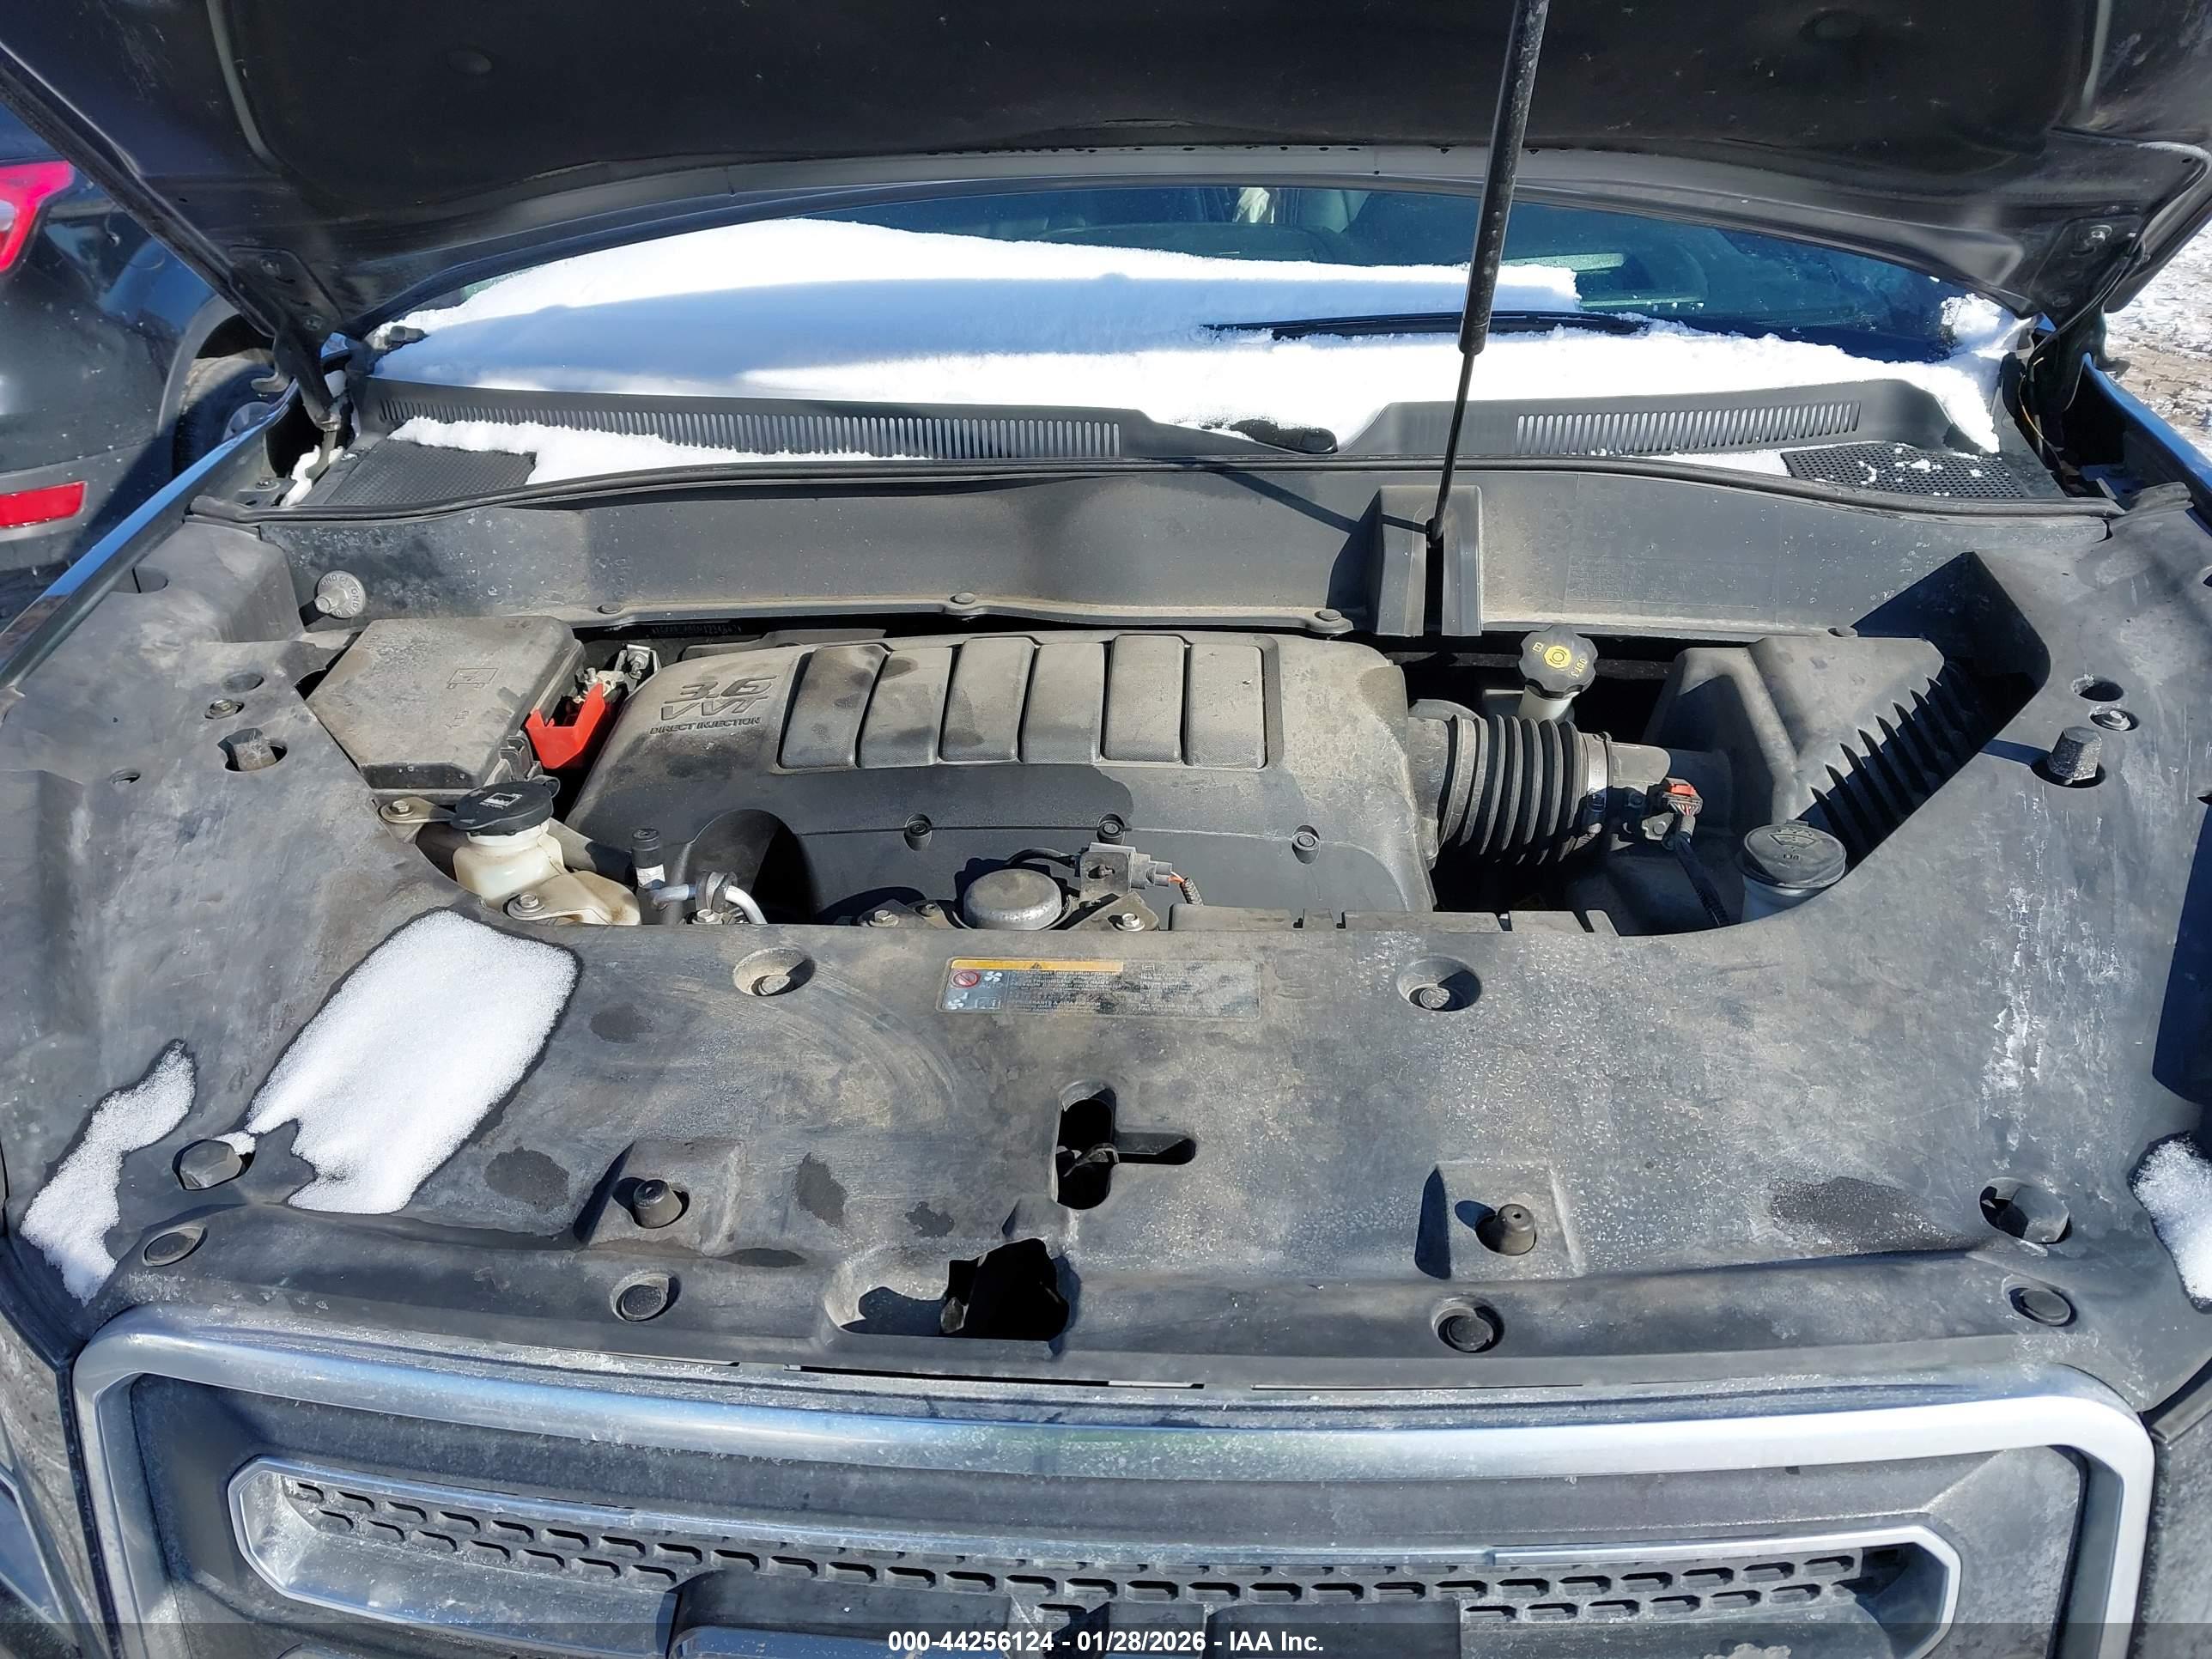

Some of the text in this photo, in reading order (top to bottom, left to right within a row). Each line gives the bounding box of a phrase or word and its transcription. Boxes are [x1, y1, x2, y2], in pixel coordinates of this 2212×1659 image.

[665, 675, 777, 704] 3.6
[661, 696, 769, 720] VVT
[650, 716, 762, 735] DIRECT INJECTION
